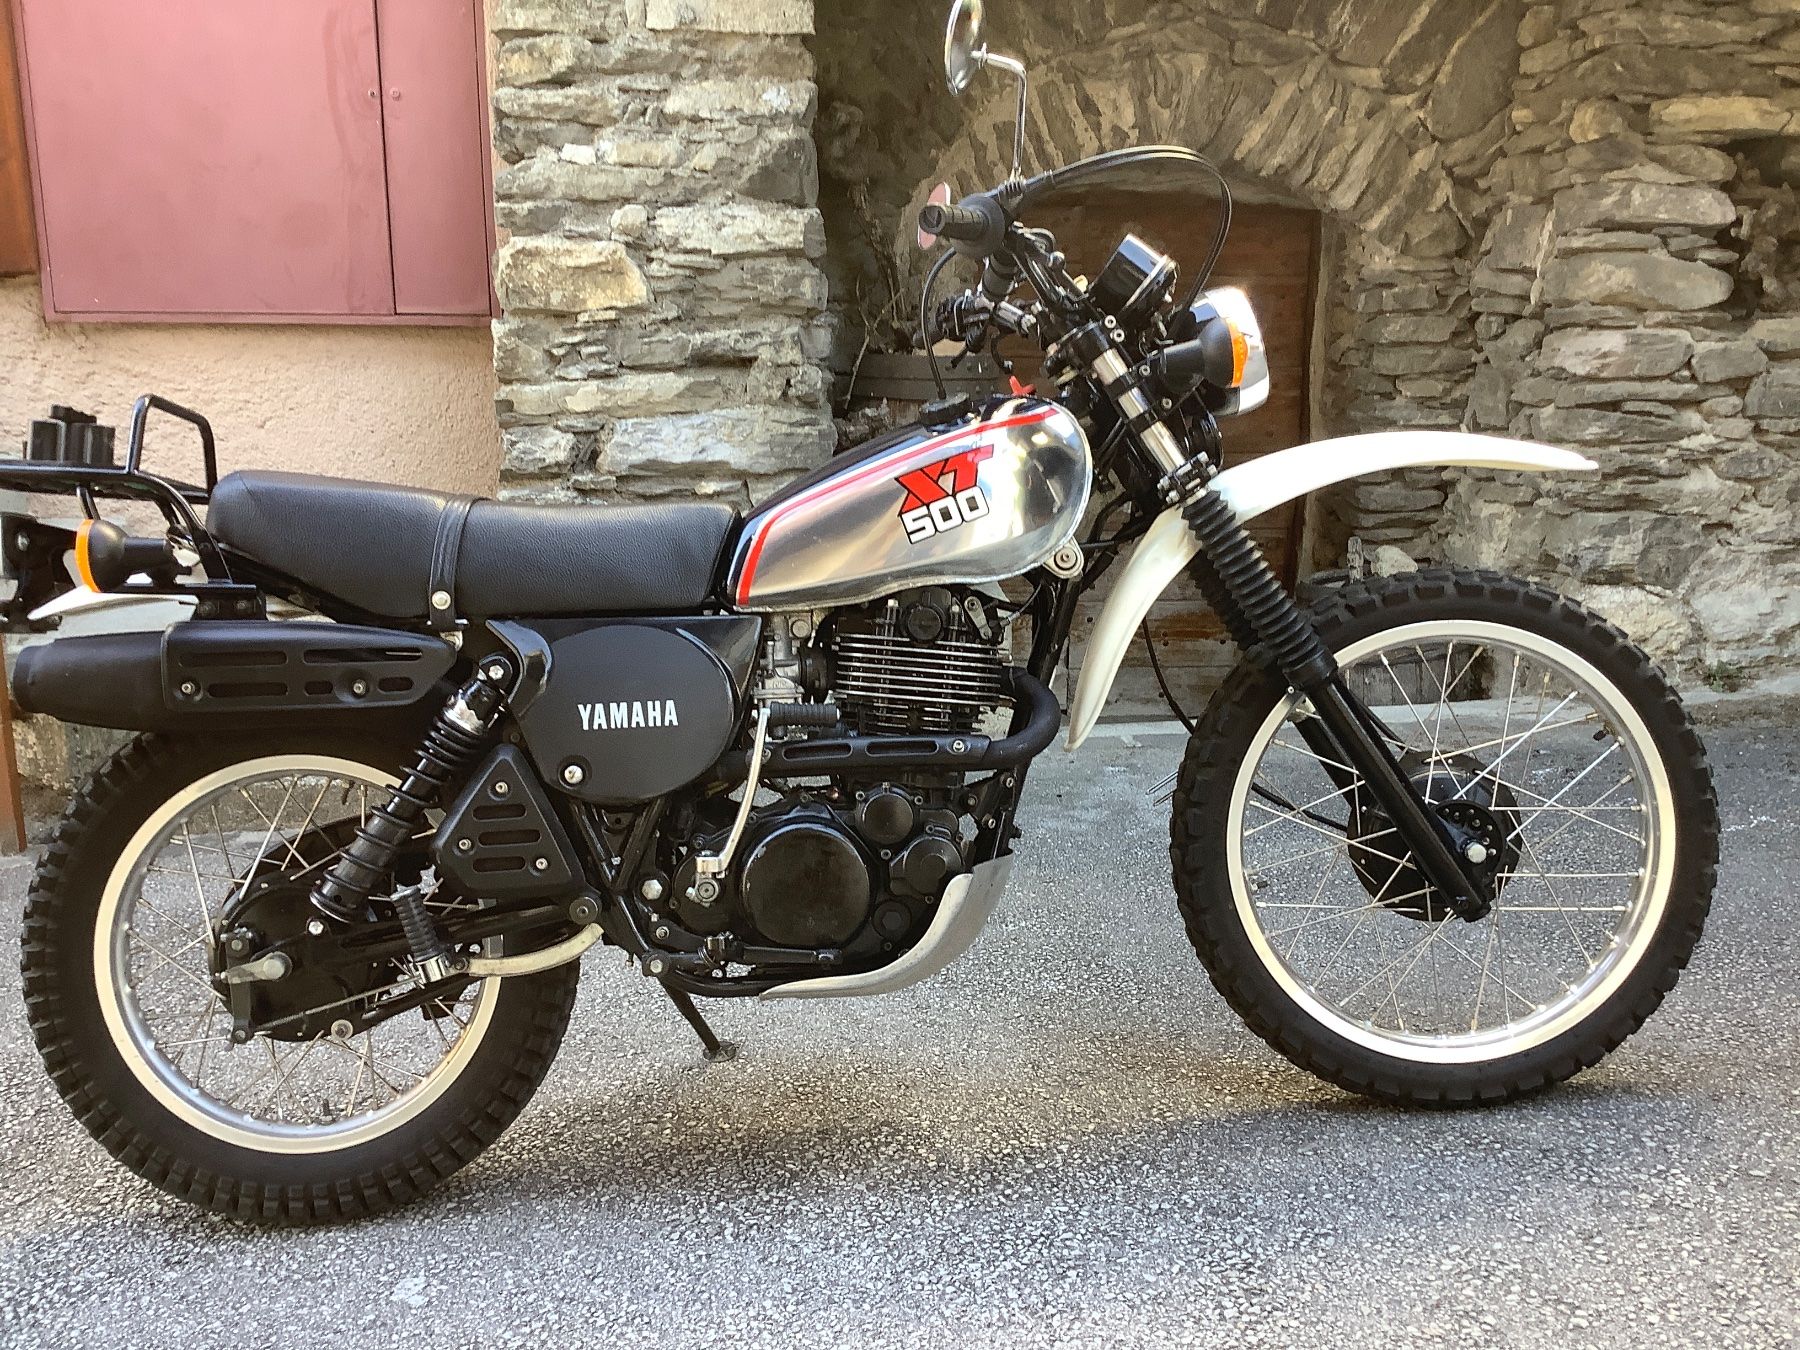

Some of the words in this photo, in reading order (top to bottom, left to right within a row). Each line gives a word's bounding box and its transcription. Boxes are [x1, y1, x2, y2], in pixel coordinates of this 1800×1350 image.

[894, 444, 994, 516] XT
[900, 486, 990, 544] 500
[577, 699, 679, 731] YAMAHA
